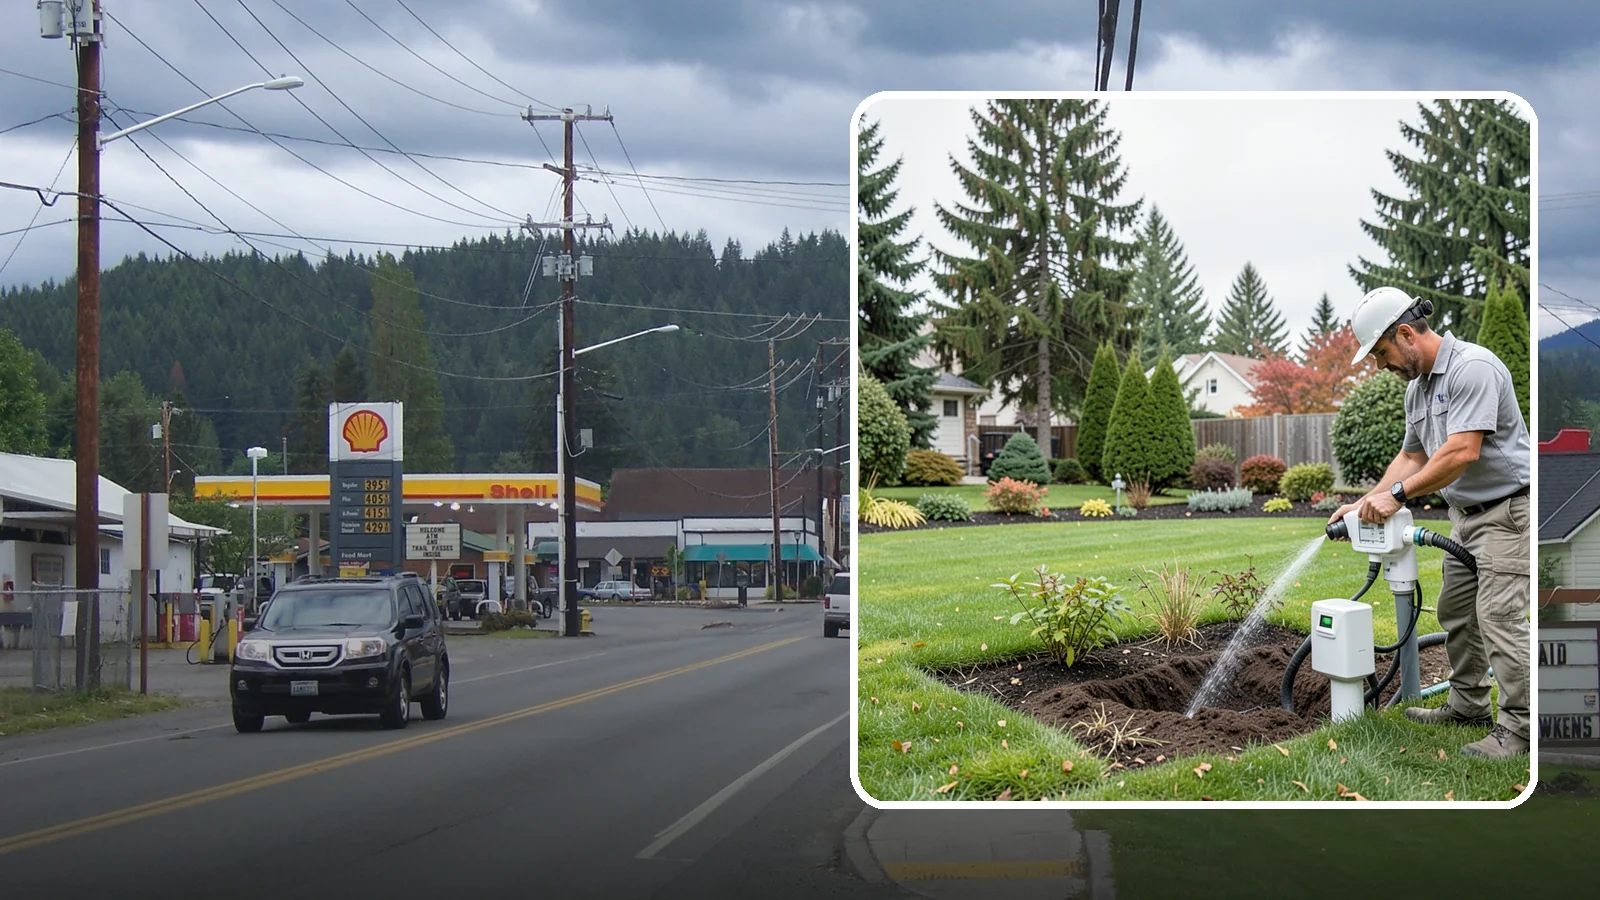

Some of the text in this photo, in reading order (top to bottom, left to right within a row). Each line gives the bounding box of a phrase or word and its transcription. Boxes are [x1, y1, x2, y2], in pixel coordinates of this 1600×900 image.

[365, 480, 384, 490] 395
[490, 484, 547, 499] Shell
[365, 494, 384, 504] 405
[365, 508, 384, 518] 415
[365, 522, 384, 533] 429
